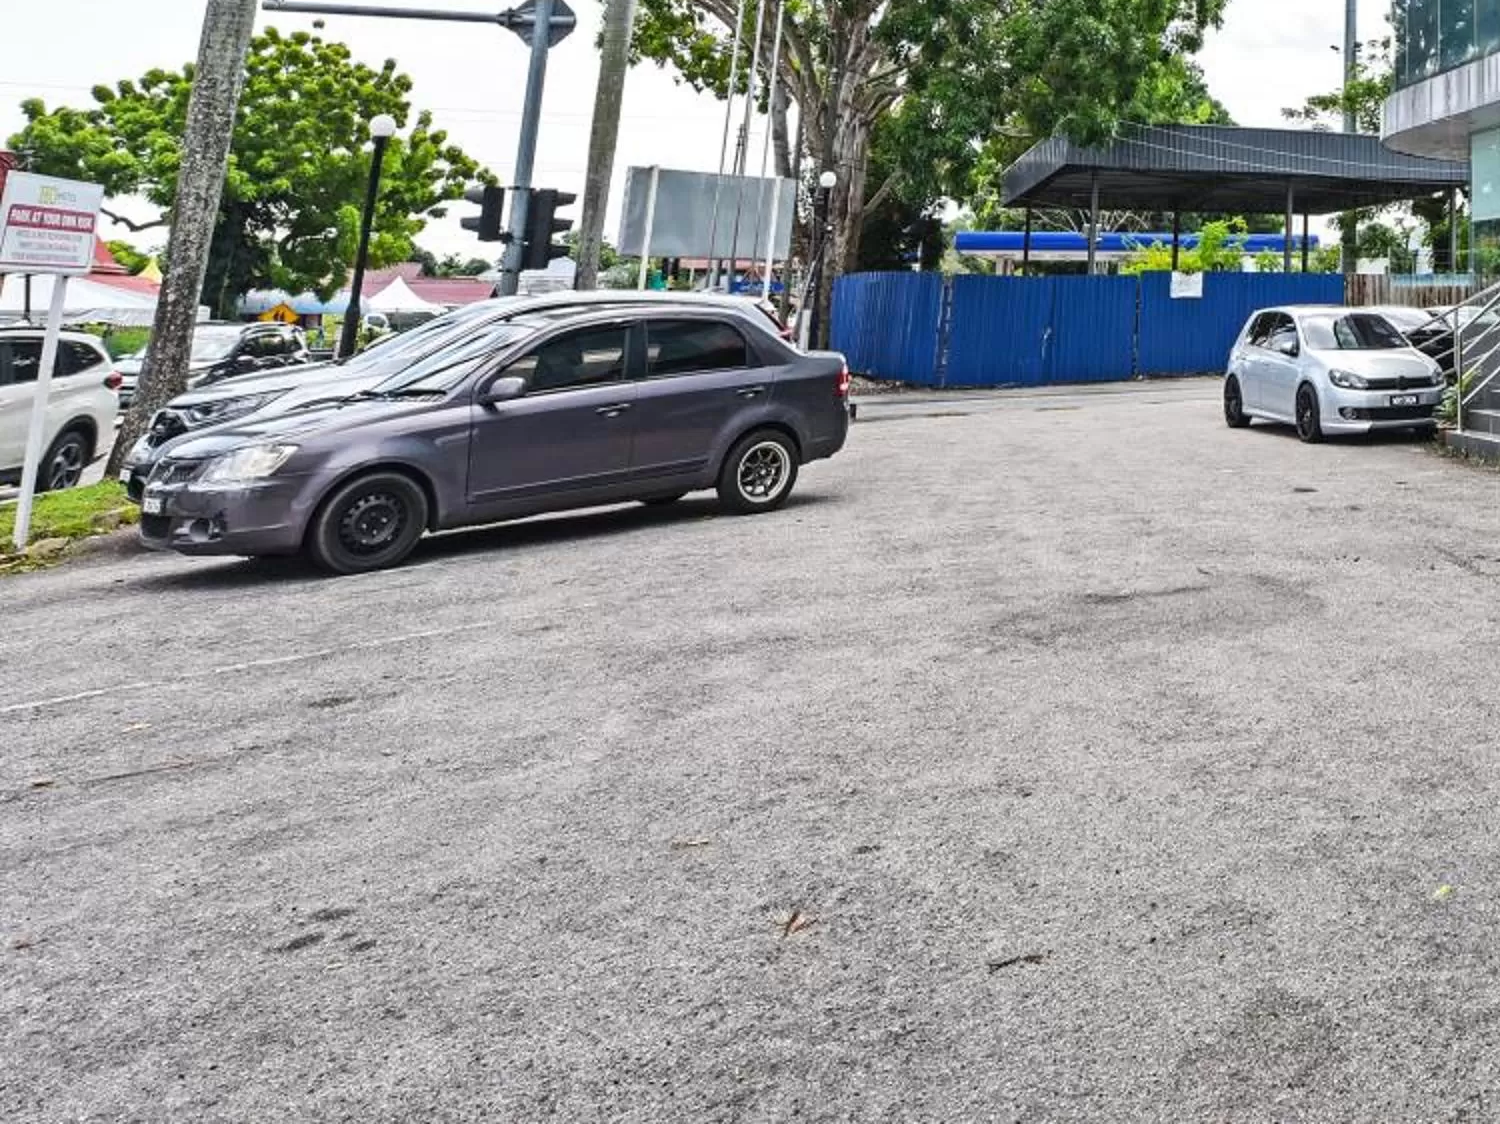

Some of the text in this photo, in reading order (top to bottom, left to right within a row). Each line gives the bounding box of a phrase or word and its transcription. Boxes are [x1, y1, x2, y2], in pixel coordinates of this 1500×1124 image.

[10, 209, 93, 229] PARK AT YOUR OWN RISK
